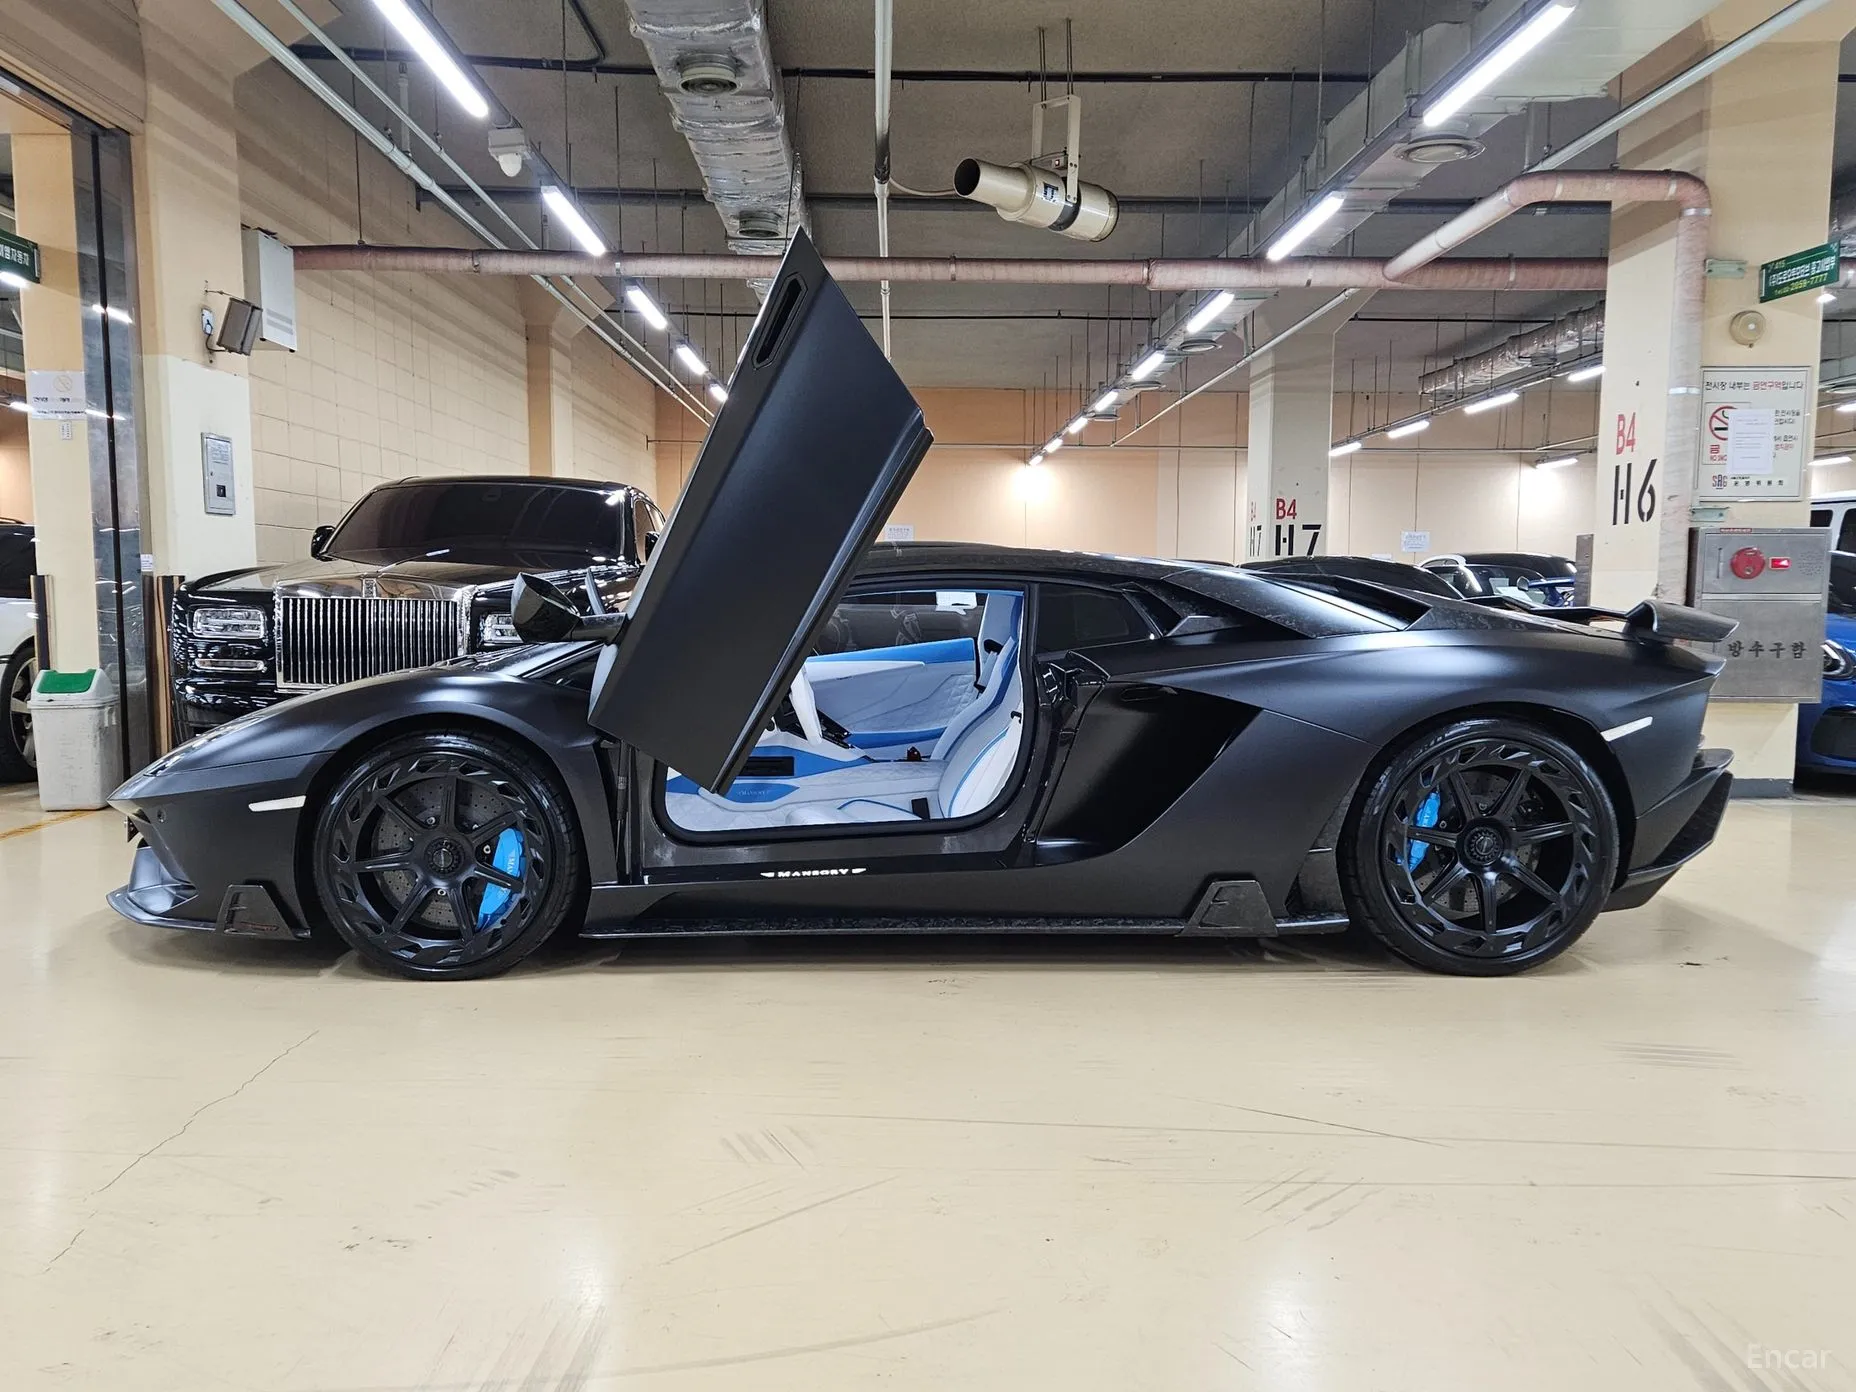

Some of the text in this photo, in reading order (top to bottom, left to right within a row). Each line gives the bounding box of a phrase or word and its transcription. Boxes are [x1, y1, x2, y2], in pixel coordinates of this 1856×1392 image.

[1705, 381, 1727, 391] 전시장
[1729, 381, 1750, 391] 내부는
[1616, 412, 1636, 455] B4
[1710, 444, 1720, 454] 금
[1612, 458, 1658, 526] H6
[1276, 498, 1297, 520] B4
[1275, 524, 1322, 556] H7
